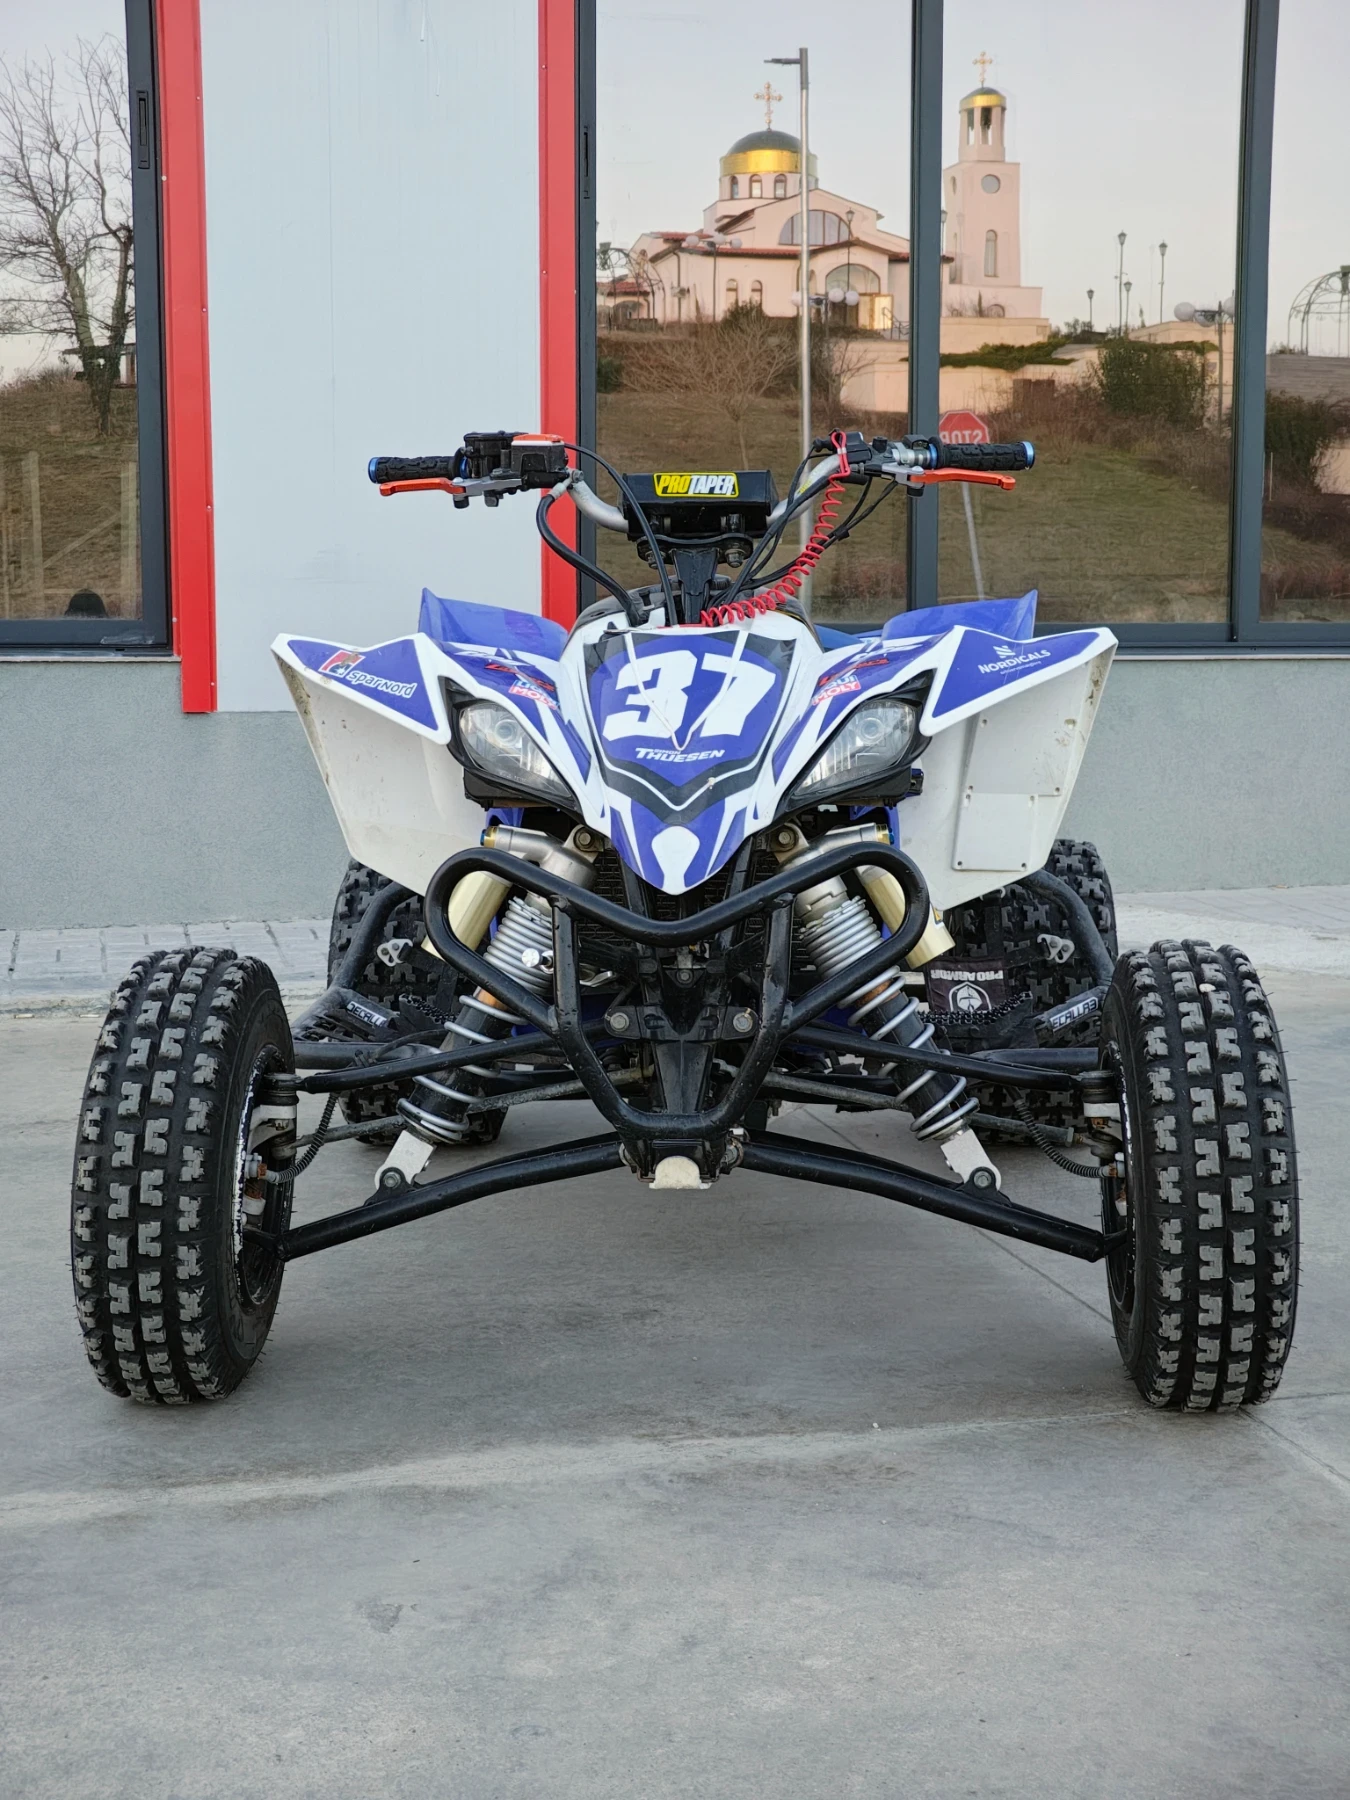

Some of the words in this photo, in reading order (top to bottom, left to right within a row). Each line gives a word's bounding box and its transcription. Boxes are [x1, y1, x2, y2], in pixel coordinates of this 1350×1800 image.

[977, 649, 1051, 674] NORDICALS
[602, 650, 776, 741] 37
[814, 682, 858, 703] MOLY
[635, 747, 725, 762] THUESEN
[930, 969, 976, 981] ARMOR
[976, 970, 1004, 981] PRO
